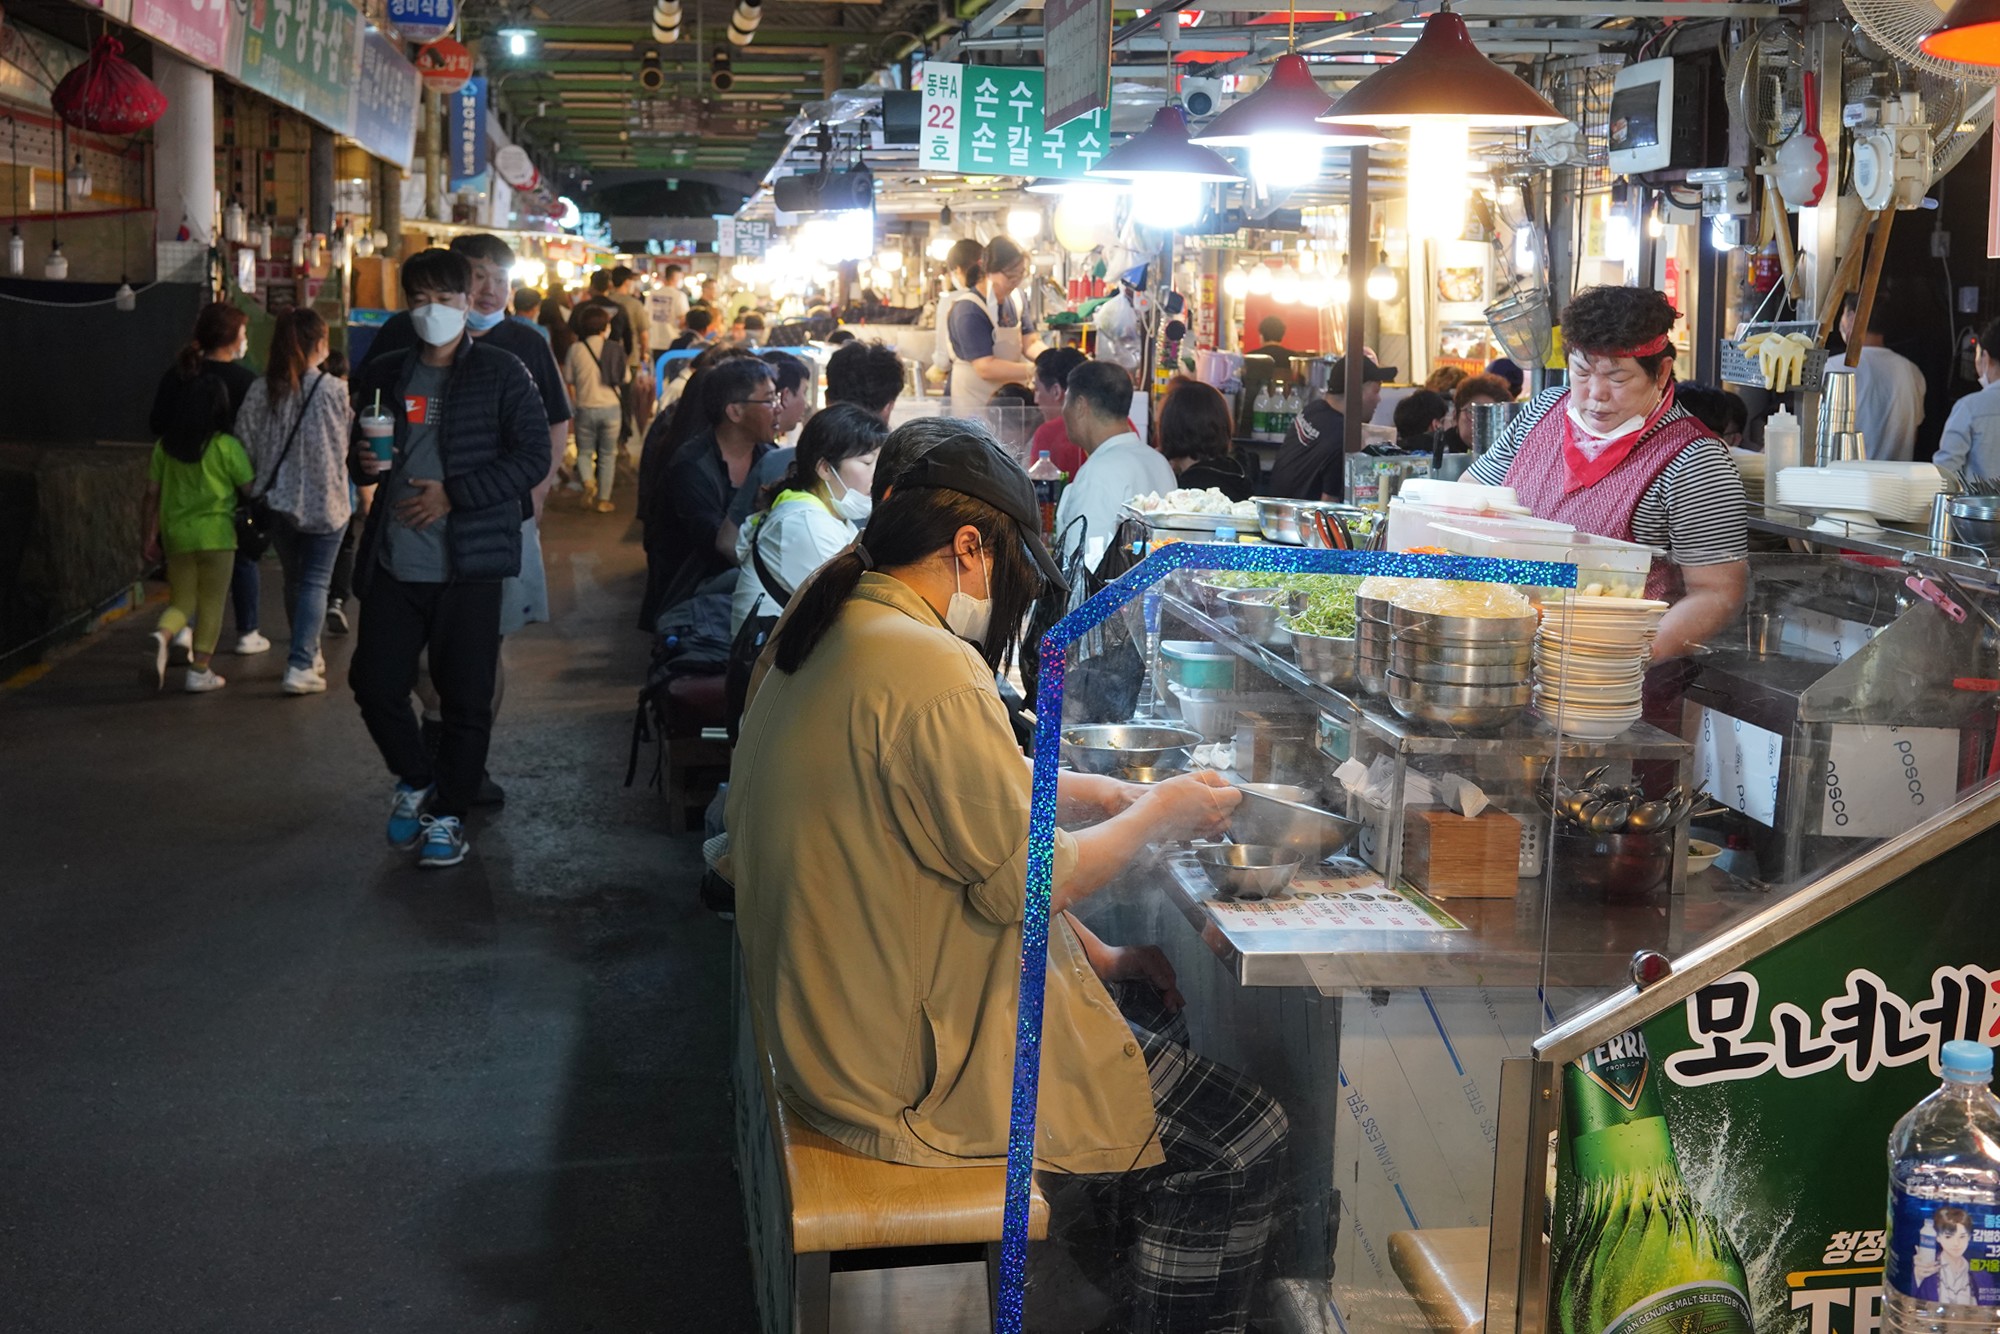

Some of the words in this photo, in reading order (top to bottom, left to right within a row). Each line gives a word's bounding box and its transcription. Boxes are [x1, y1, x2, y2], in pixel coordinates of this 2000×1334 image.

[927, 73, 957, 98] 동부A
[927, 104, 954, 129] 22
[929, 135, 950, 161] 호
[971, 122, 1102, 171] 손칼국수
[1894, 739, 1925, 806] posco
[1605, 1061, 1626, 1073] FROM
[1462, 1078, 1487, 1115] STEEL
[1361, 1117, 1400, 1182] STAINLESS
[1639, 1305, 1675, 1325] GENUINE
[1675, 1295, 1698, 1309] MALT
[1699, 1293, 1733, 1306] SELECTED
[1702, 1320, 1728, 1334] QUALITY
